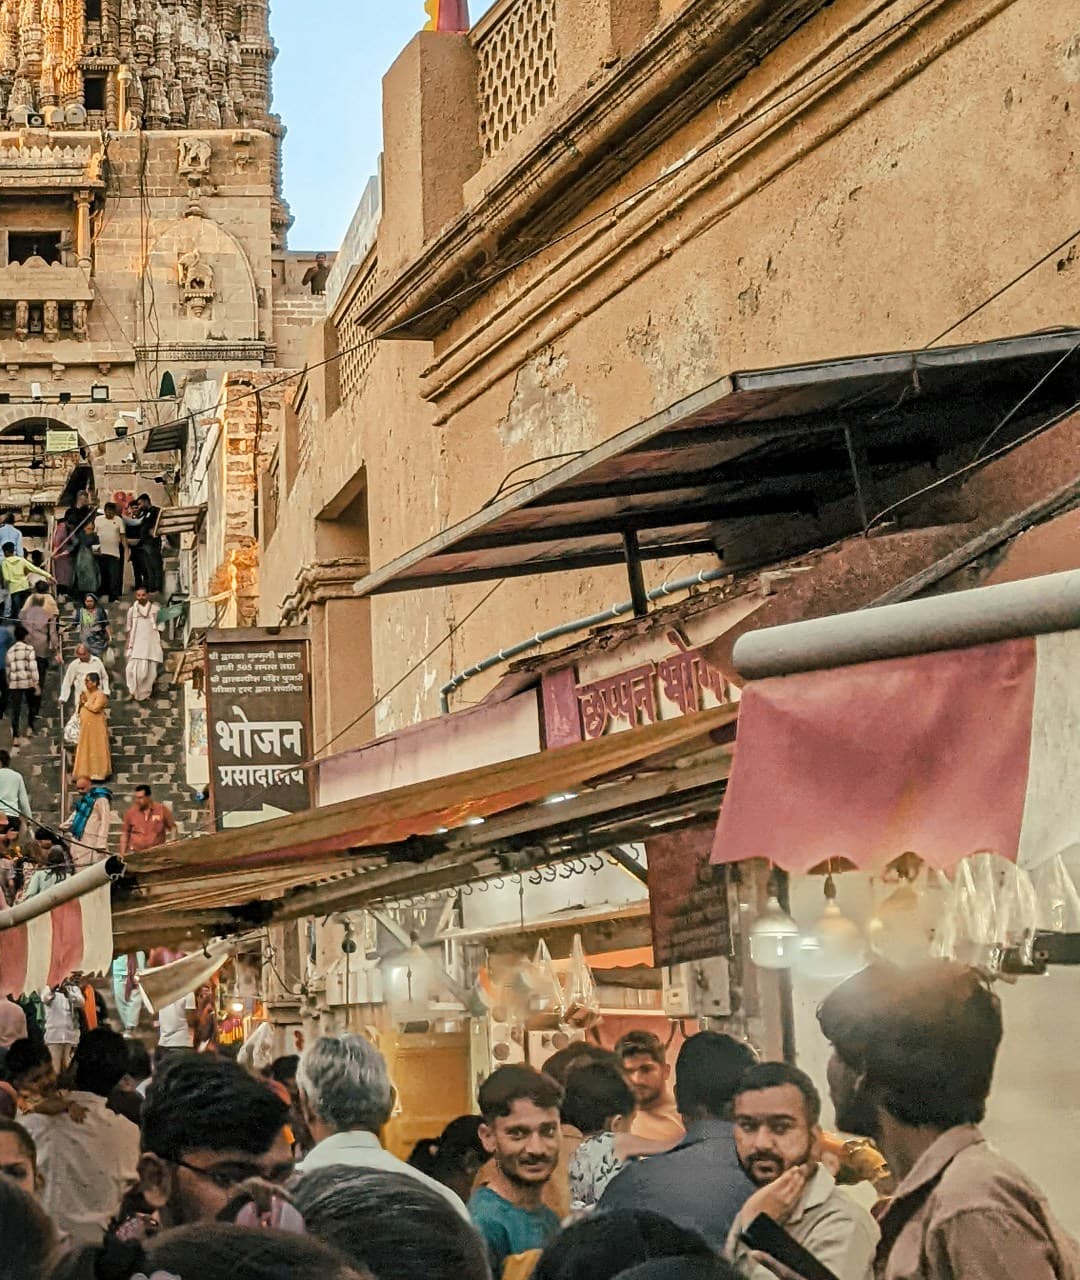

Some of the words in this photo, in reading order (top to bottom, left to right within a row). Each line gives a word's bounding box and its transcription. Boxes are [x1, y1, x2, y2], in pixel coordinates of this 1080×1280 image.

[236, 663, 252, 671] 505
[215, 705, 304, 758] भोजन
[217, 764, 304, 788] प्रसादालय
